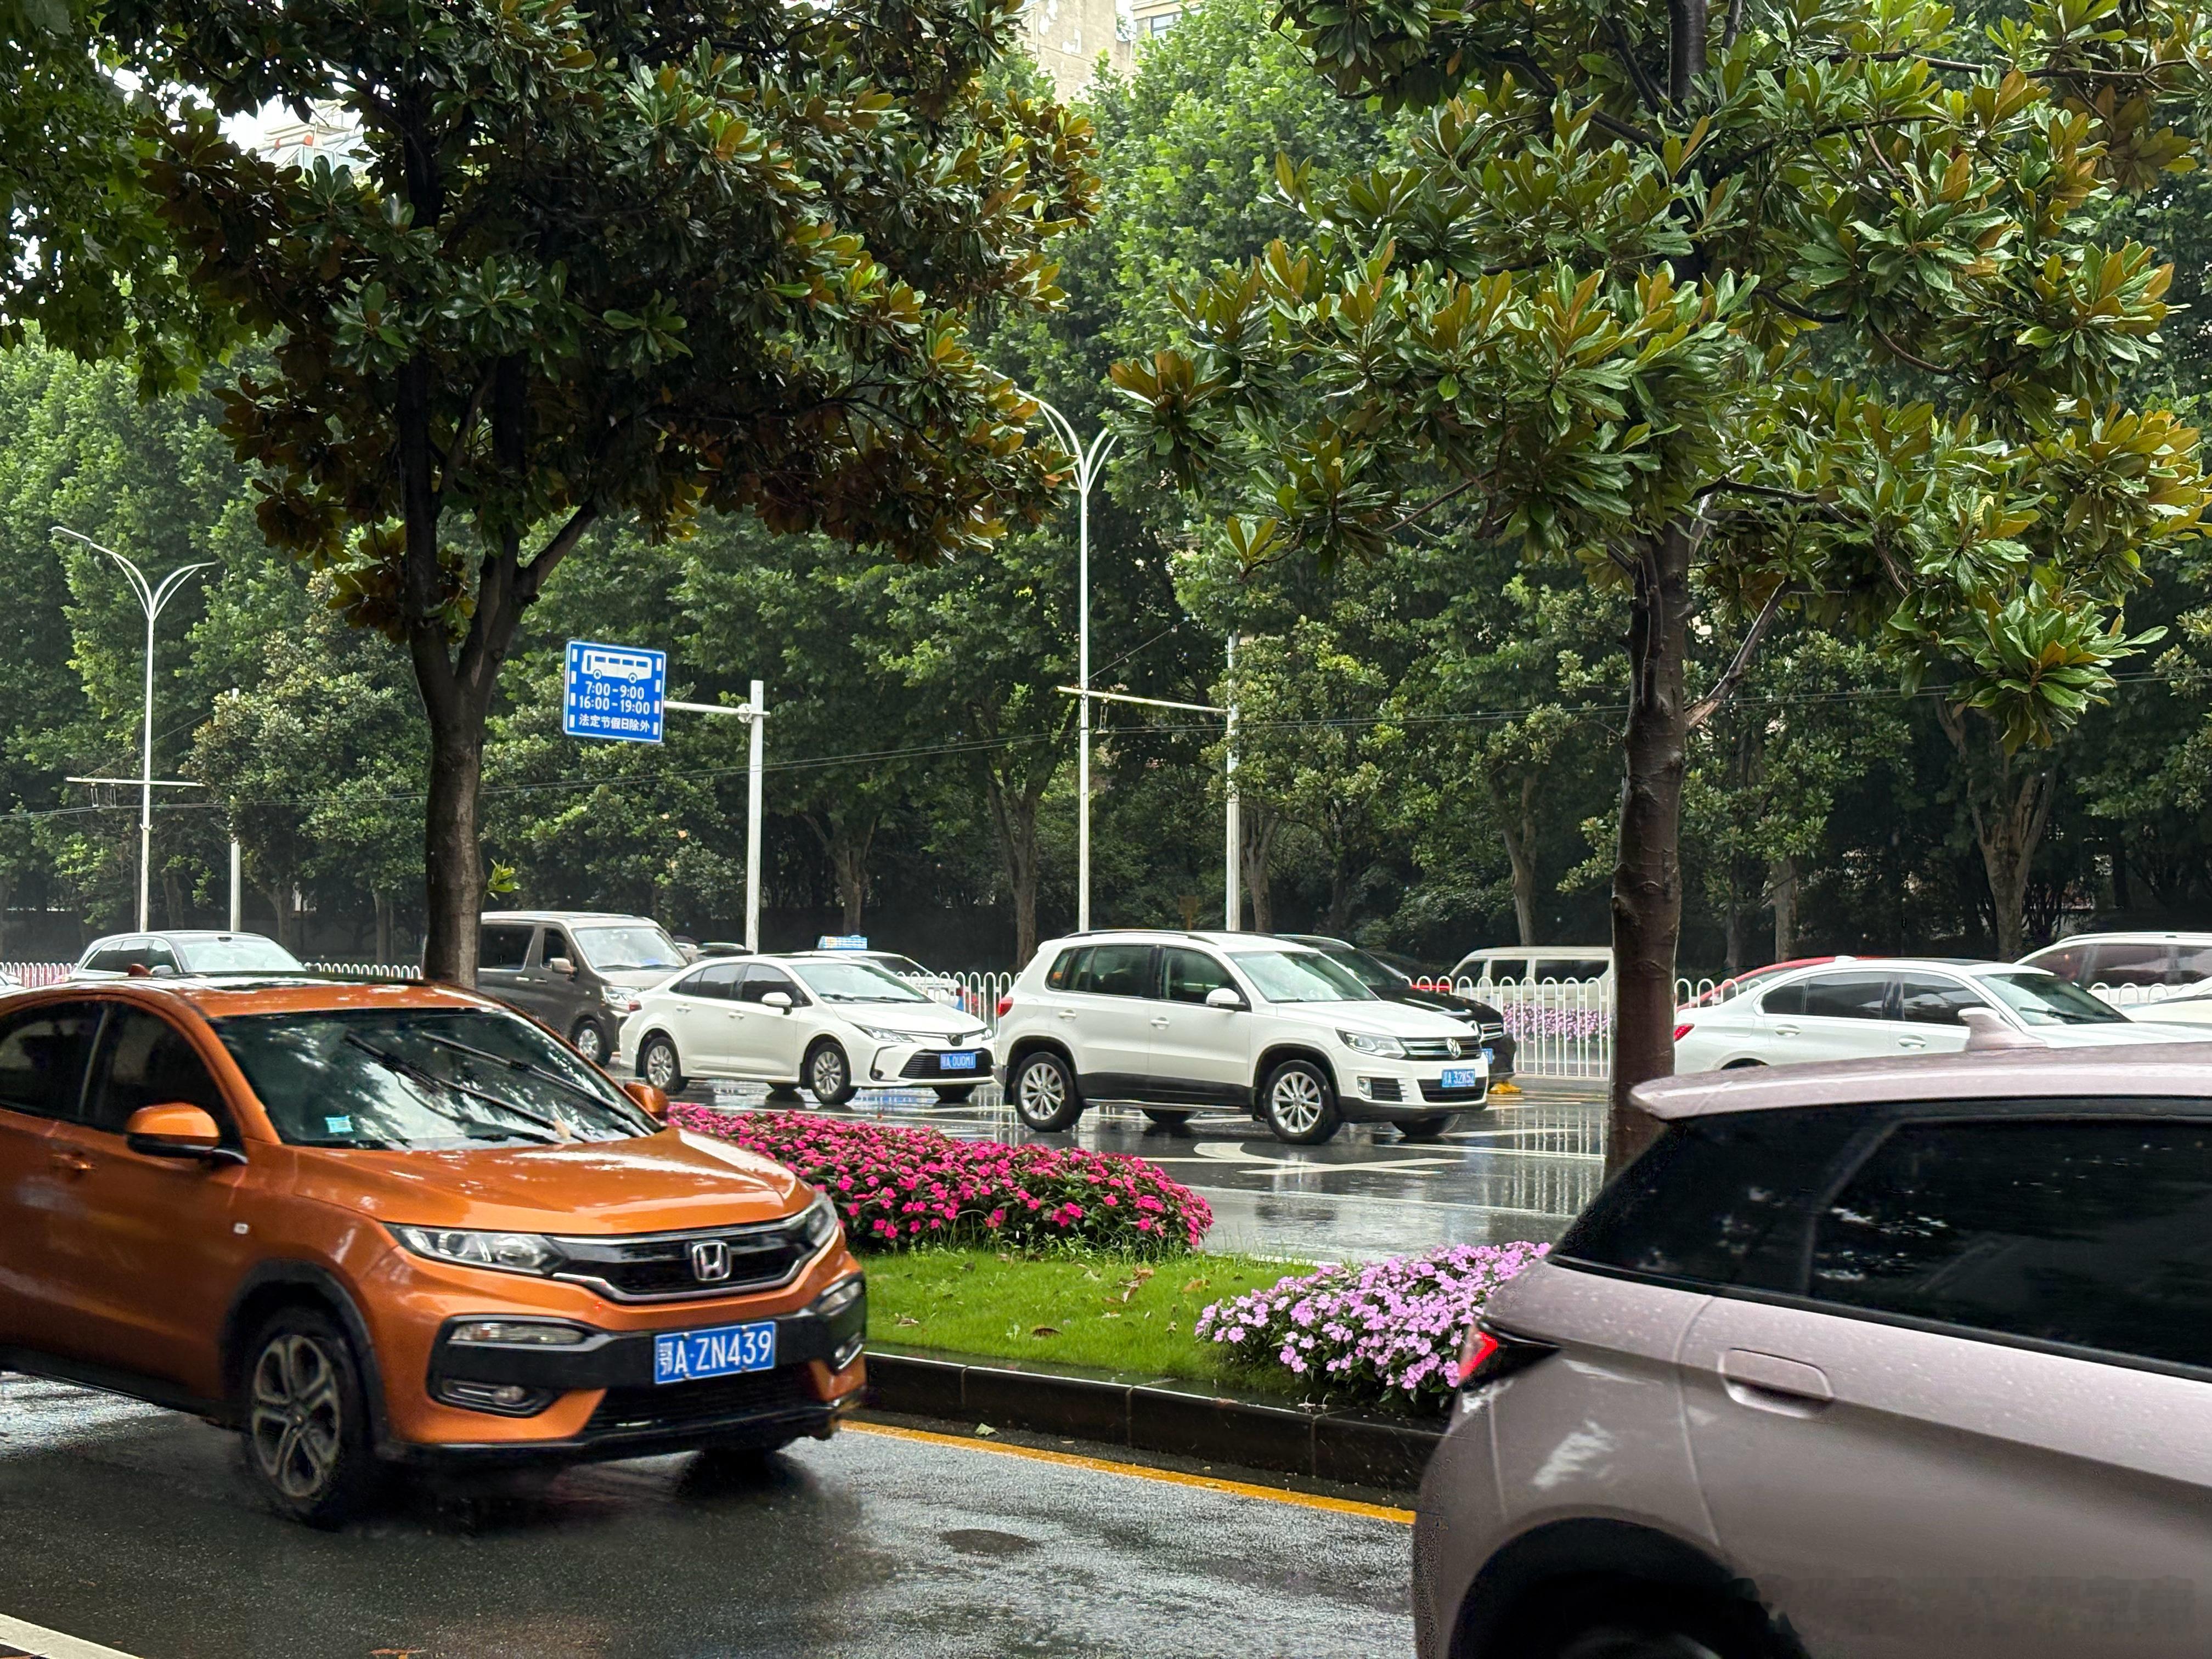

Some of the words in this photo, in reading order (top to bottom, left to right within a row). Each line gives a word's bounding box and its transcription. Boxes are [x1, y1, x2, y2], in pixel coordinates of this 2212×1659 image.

[579, 713, 650, 733] 法定节假日除外
